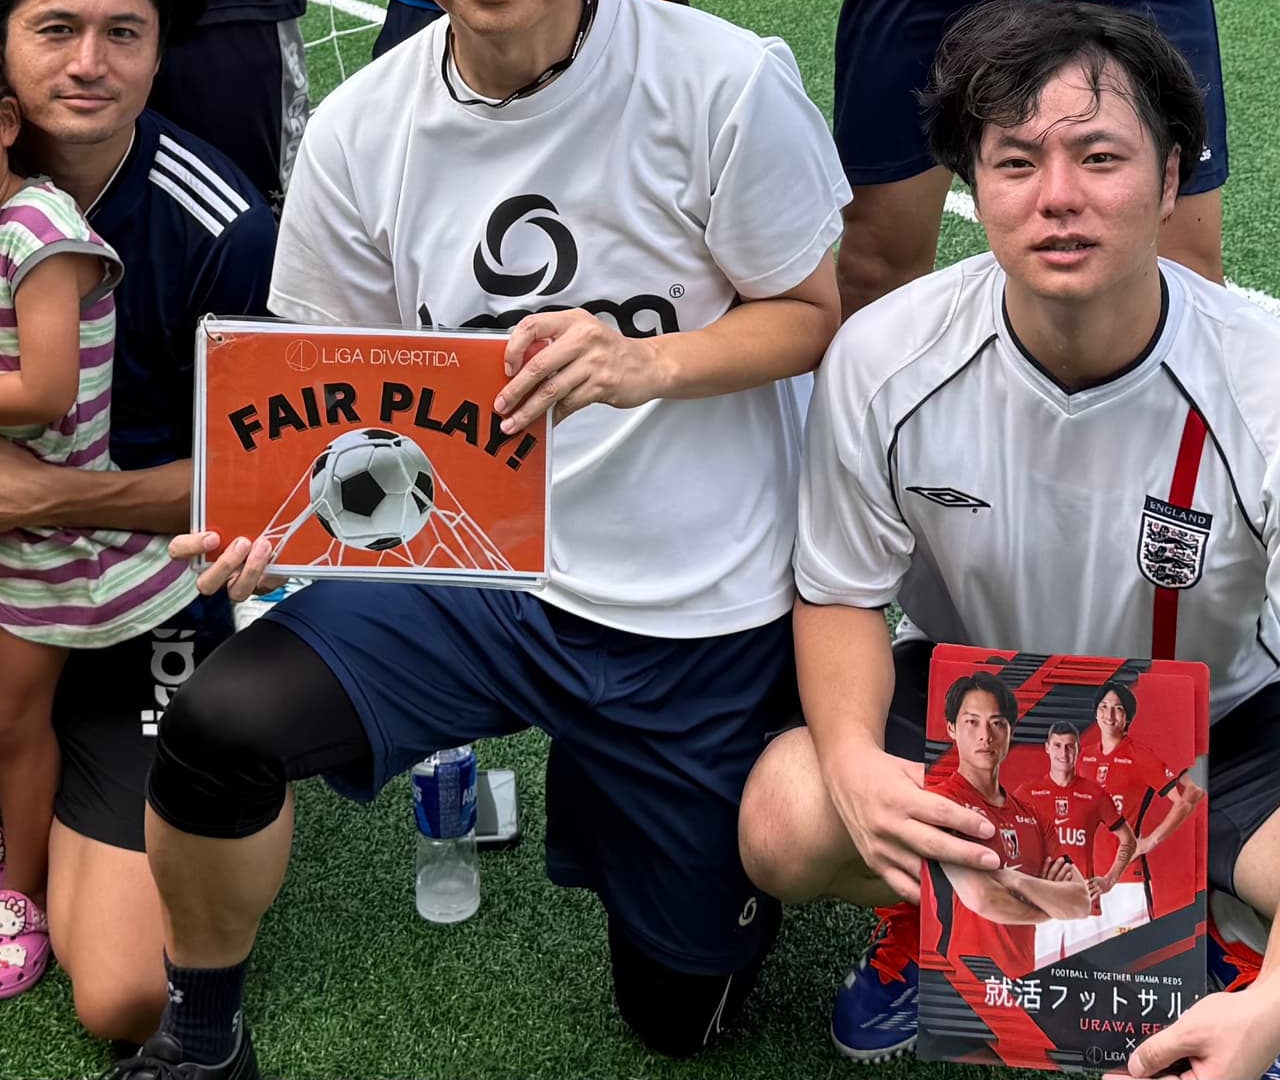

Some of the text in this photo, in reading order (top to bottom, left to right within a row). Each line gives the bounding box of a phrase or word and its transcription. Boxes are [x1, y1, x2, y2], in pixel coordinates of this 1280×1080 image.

[228, 381, 537, 471] FAIR PLAY!
[1150, 501, 1206, 525] ENGLAND
[1056, 826, 1086, 846] LUS
[1051, 968, 1183, 986] FOOTBALL TOGETHER URAWA REDS
[984, 975, 1199, 1019] 就活フットサル
[1079, 1017, 1135, 1034] URAWA
